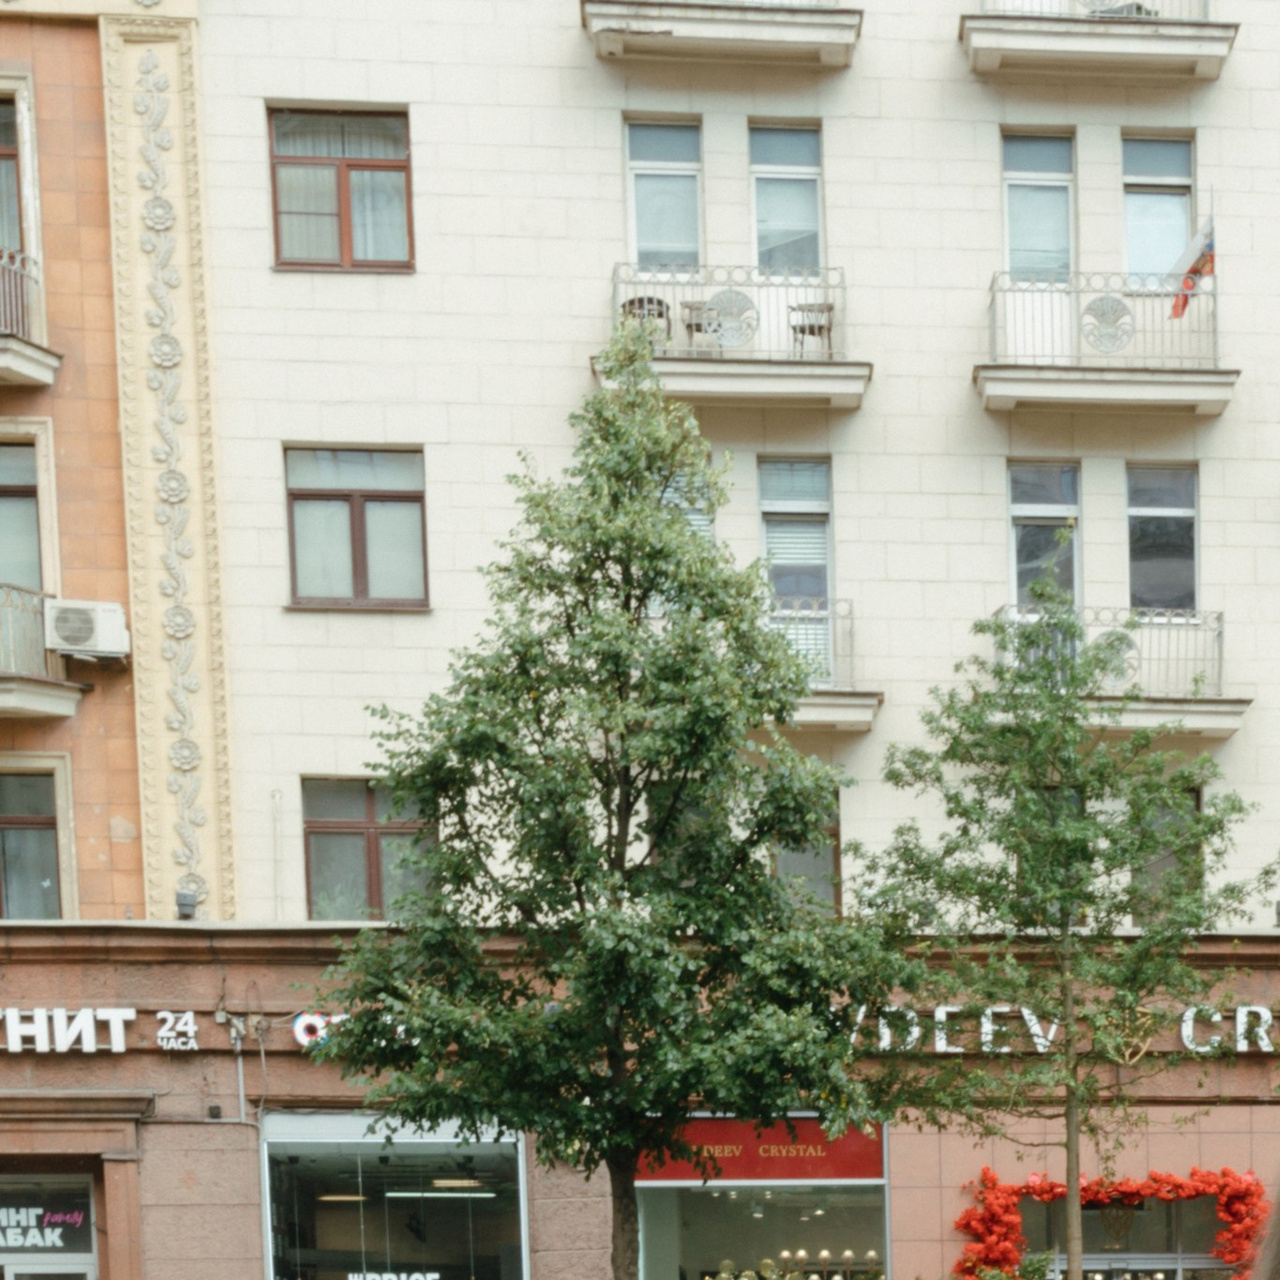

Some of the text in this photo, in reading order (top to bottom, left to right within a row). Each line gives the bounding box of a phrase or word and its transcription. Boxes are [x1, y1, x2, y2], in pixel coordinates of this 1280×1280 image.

[0, 1007, 137, 1053] НИТ
[156, 1011, 197, 1037] 24
[157, 1037, 199, 1050] ЧАСА
[758, 1144, 827, 1157] CRYSTAL
